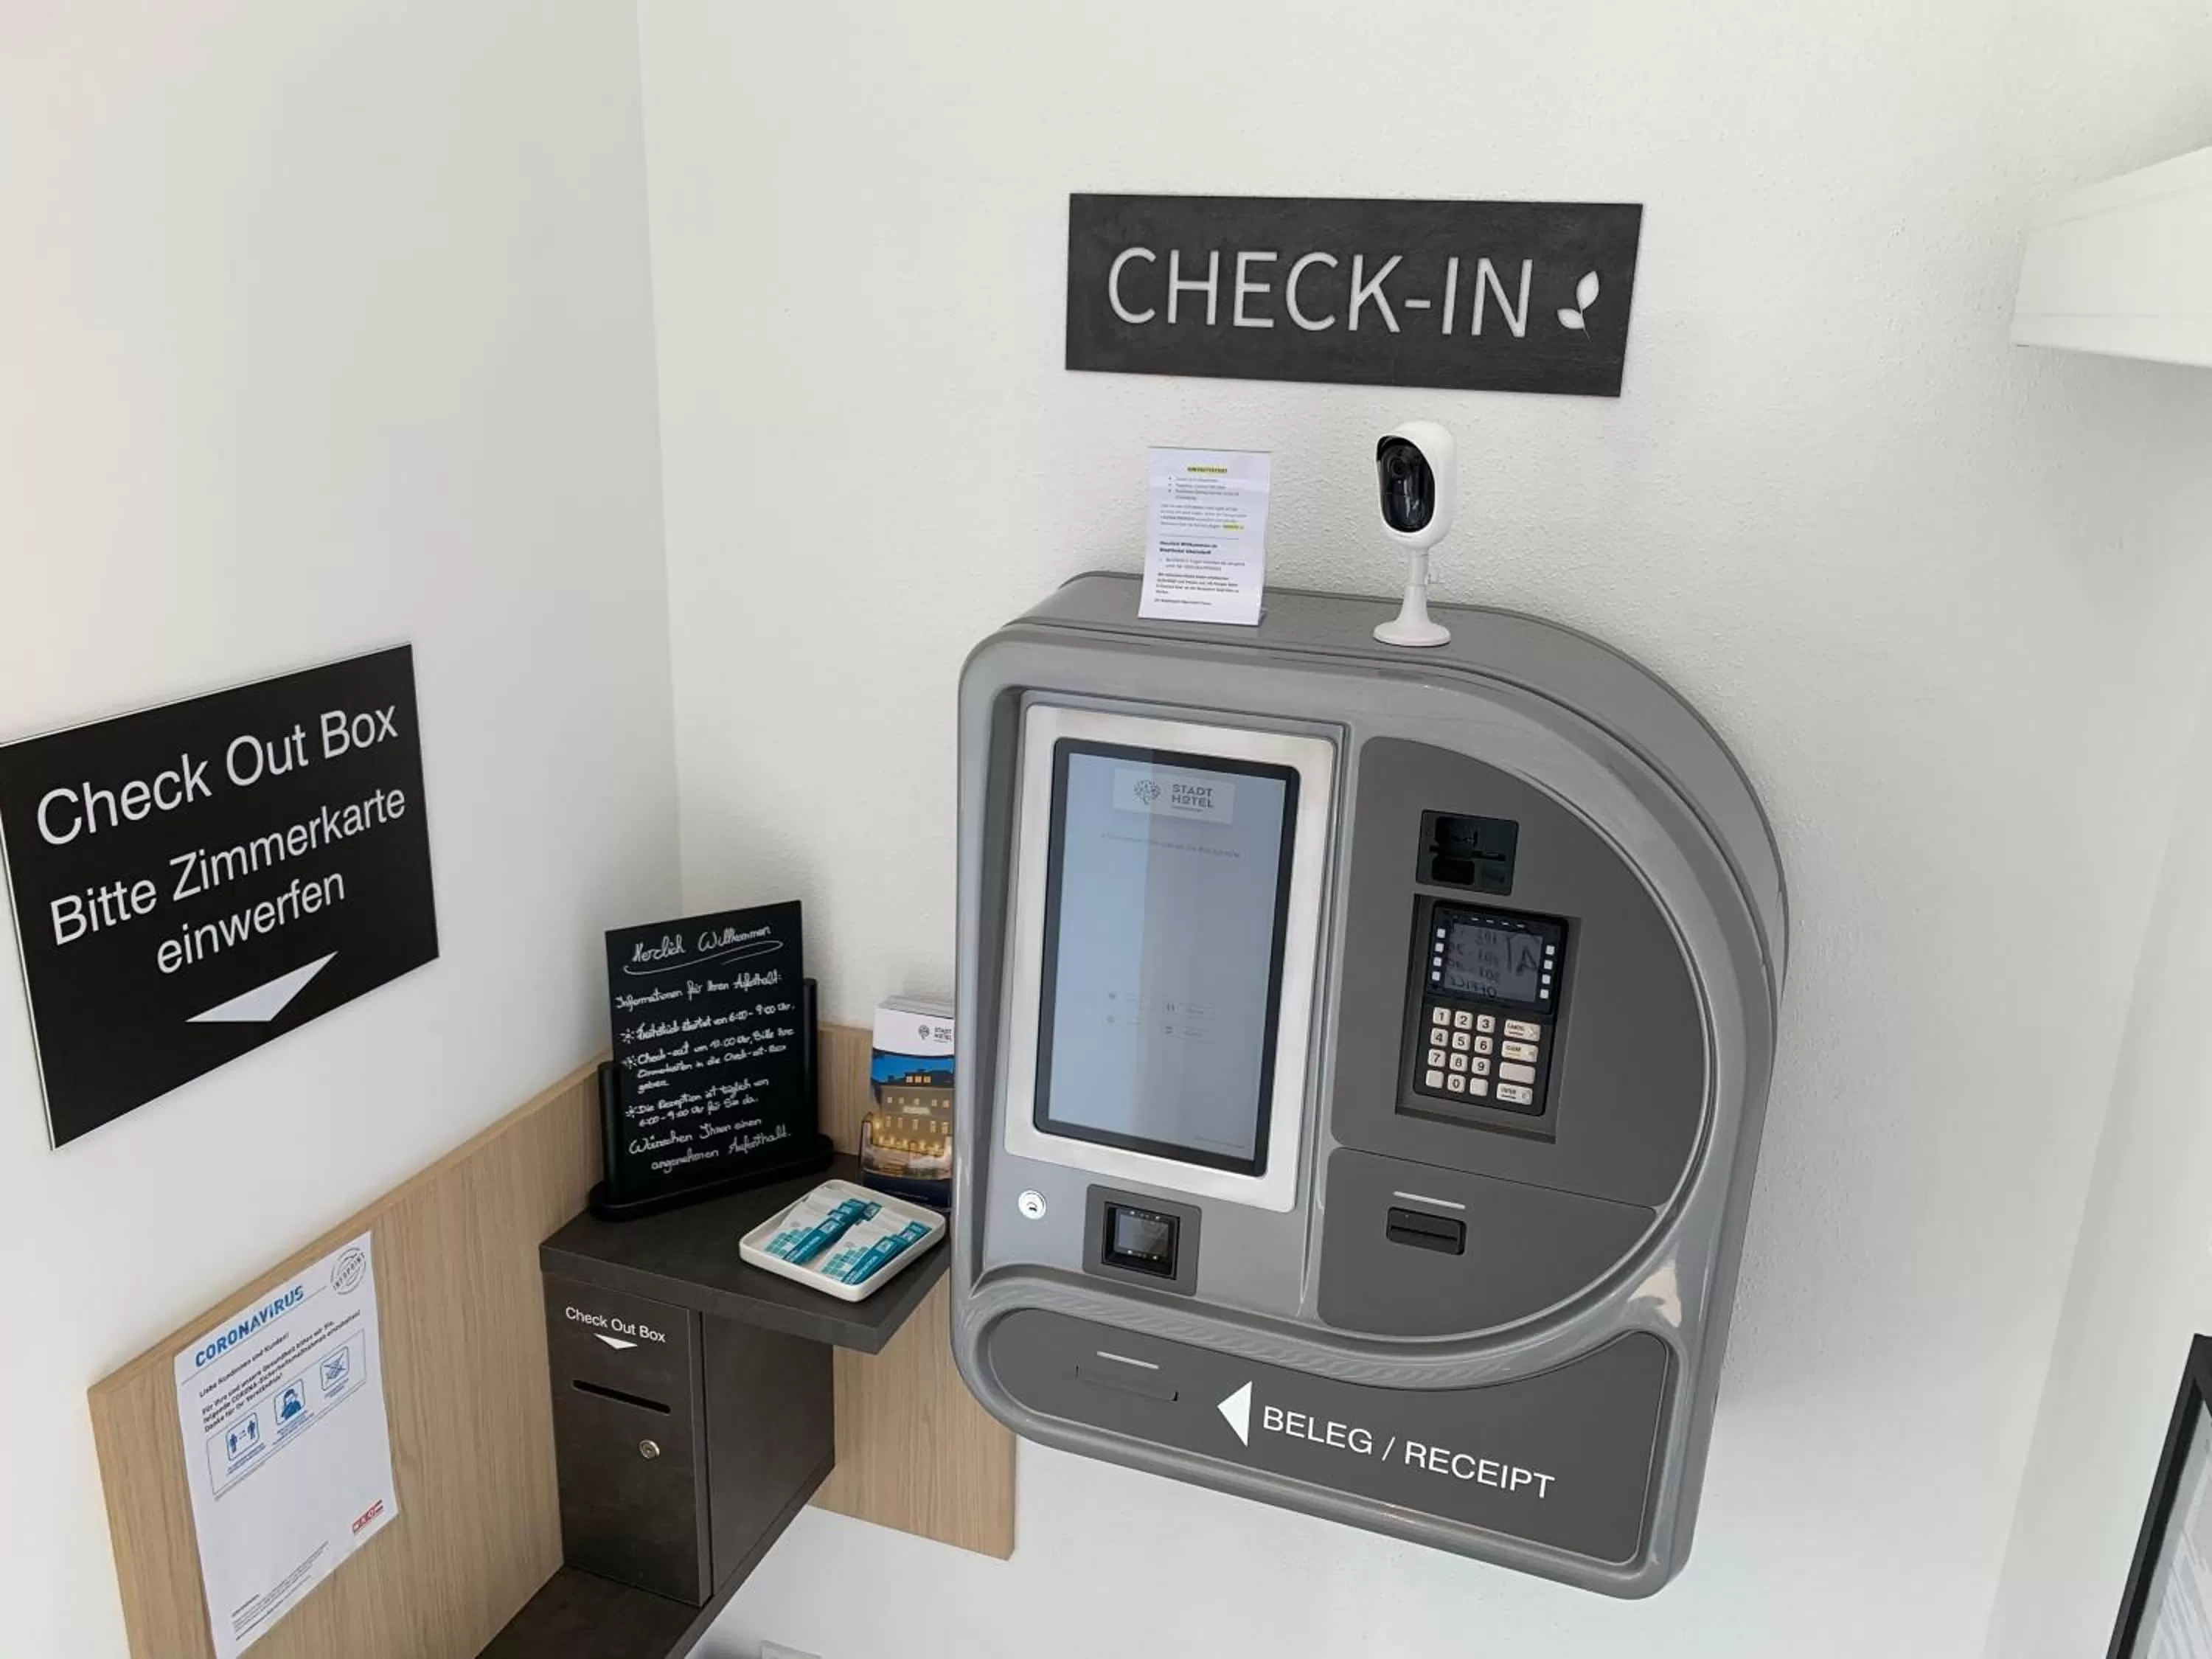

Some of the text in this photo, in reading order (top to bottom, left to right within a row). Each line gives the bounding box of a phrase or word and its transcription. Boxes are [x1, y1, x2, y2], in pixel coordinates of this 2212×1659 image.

[1107, 246, 1534, 338] CHECK-IN
[36, 704, 400, 846] Check Out Box
[1172, 783, 1214, 797] STADT
[1171, 794, 1215, 809] HOTEL
[49, 787, 406, 947] Bitte Zimmerkarte
[156, 872, 347, 975] einwerfen
[633, 925, 772, 962] Herzlich Willkommen
[615, 987, 683, 1012] Informationen
[686, 980, 704, 1001] für
[1439, 1011, 1444, 1022] 1
[1459, 1015, 1468, 1026] 2
[1481, 1018, 1490, 1029] 3
[1435, 1032, 1443, 1043] 4
[1457, 1036, 1465, 1047] 5
[1479, 1040, 1488, 1051] 6
[1433, 1053, 1485, 1072] 7 8 9
[1452, 1078, 1460, 1089] 0
[628, 1129, 694, 1155] Wünschen
[699, 1123, 731, 1139] Ihnen
[195, 1284, 305, 1367] CORONAVIRUS
[565, 1307, 667, 1343] Check Out Box
[1262, 1405, 1556, 1500] BELEG / RECEIPT
